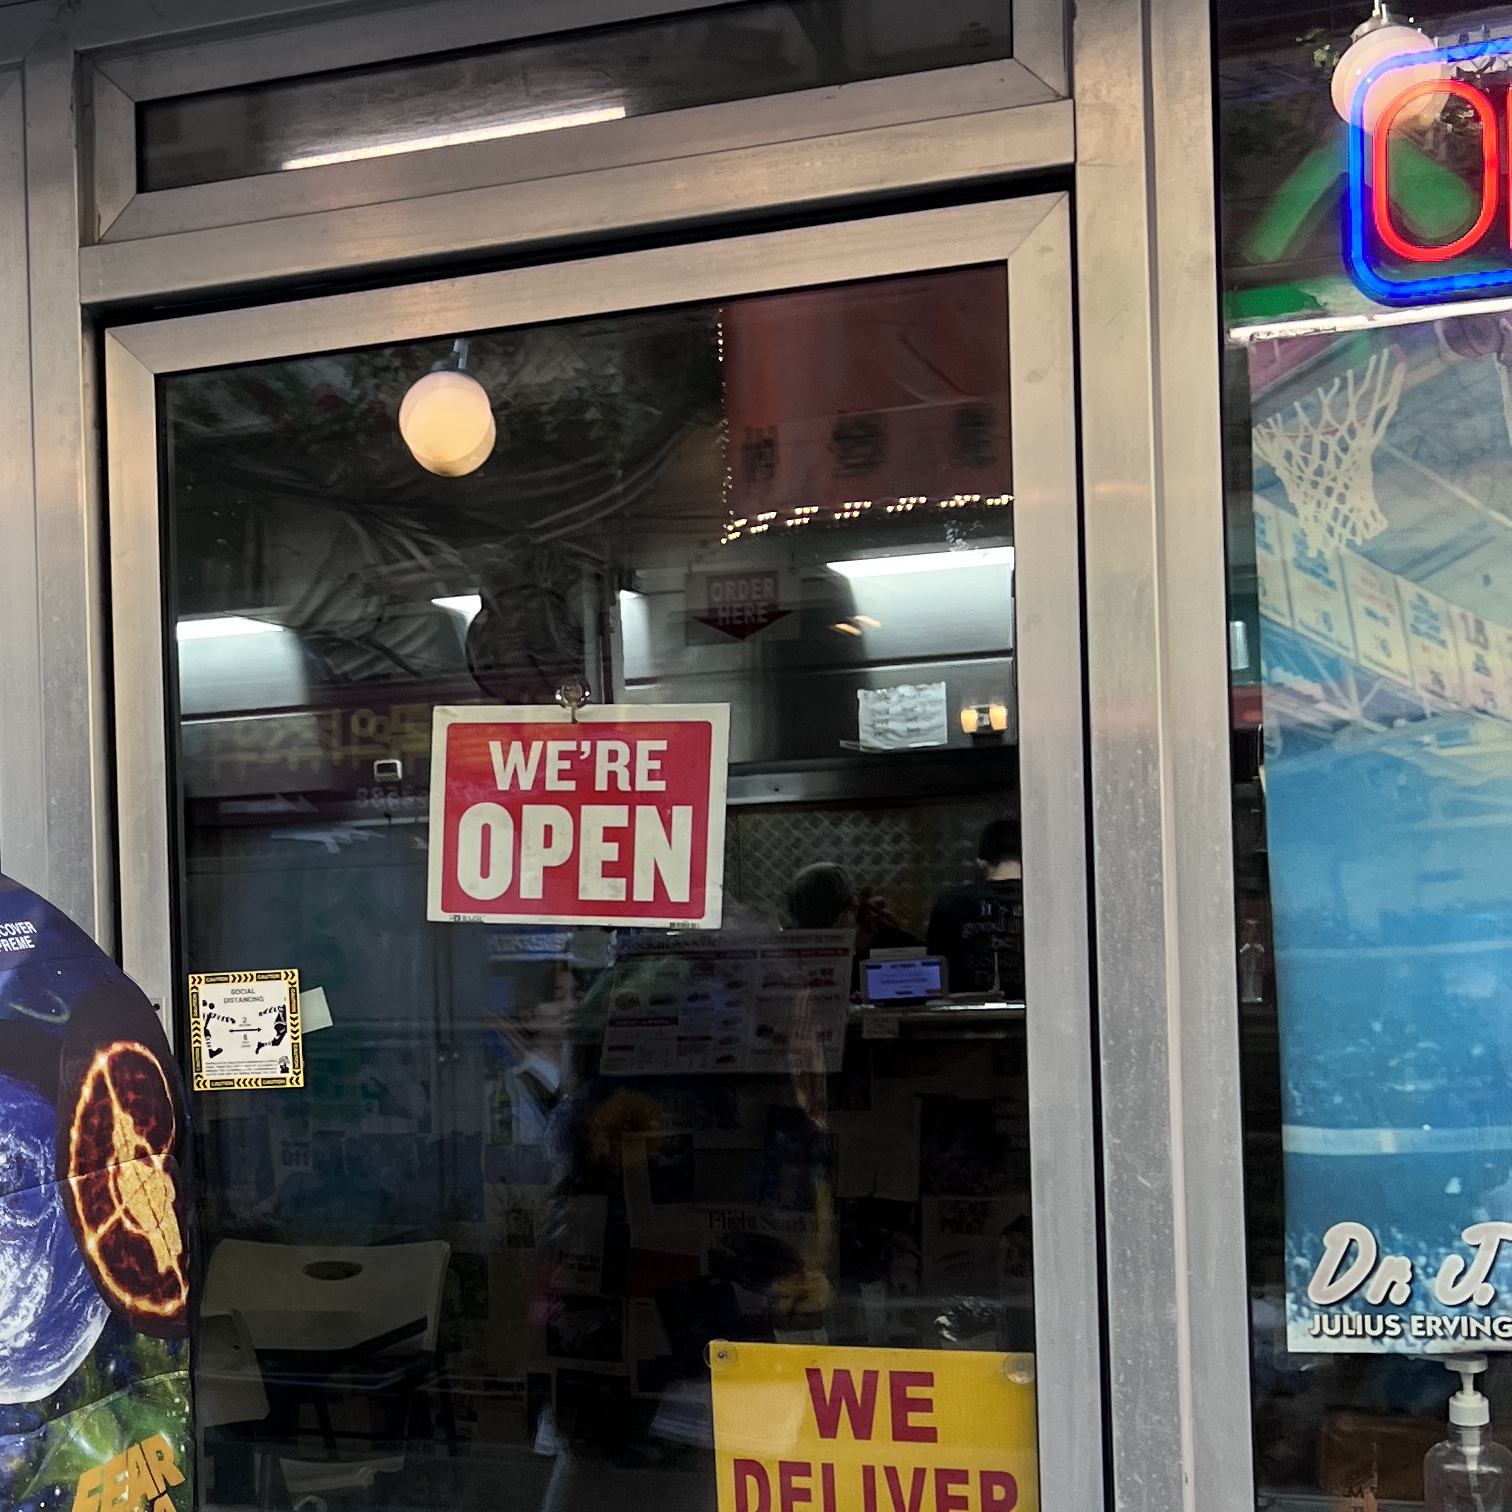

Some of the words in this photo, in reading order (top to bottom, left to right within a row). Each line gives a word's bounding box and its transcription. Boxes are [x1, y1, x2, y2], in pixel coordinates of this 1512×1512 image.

[1372, 79, 1512, 263] O
[711, 577, 776, 602] ORDER
[716, 603, 769, 626] HERE
[488, 739, 668, 793] WE'RE
[456, 801, 693, 903] OPEN
[223, 996, 263, 1004] DISTANCING
[1307, 1221, 1413, 1307] Dr.
[1309, 1314, 1401, 1337] JULIUS
[1410, 1314, 1512, 1338] ERVING
[805, 1367, 938, 1443] WE
